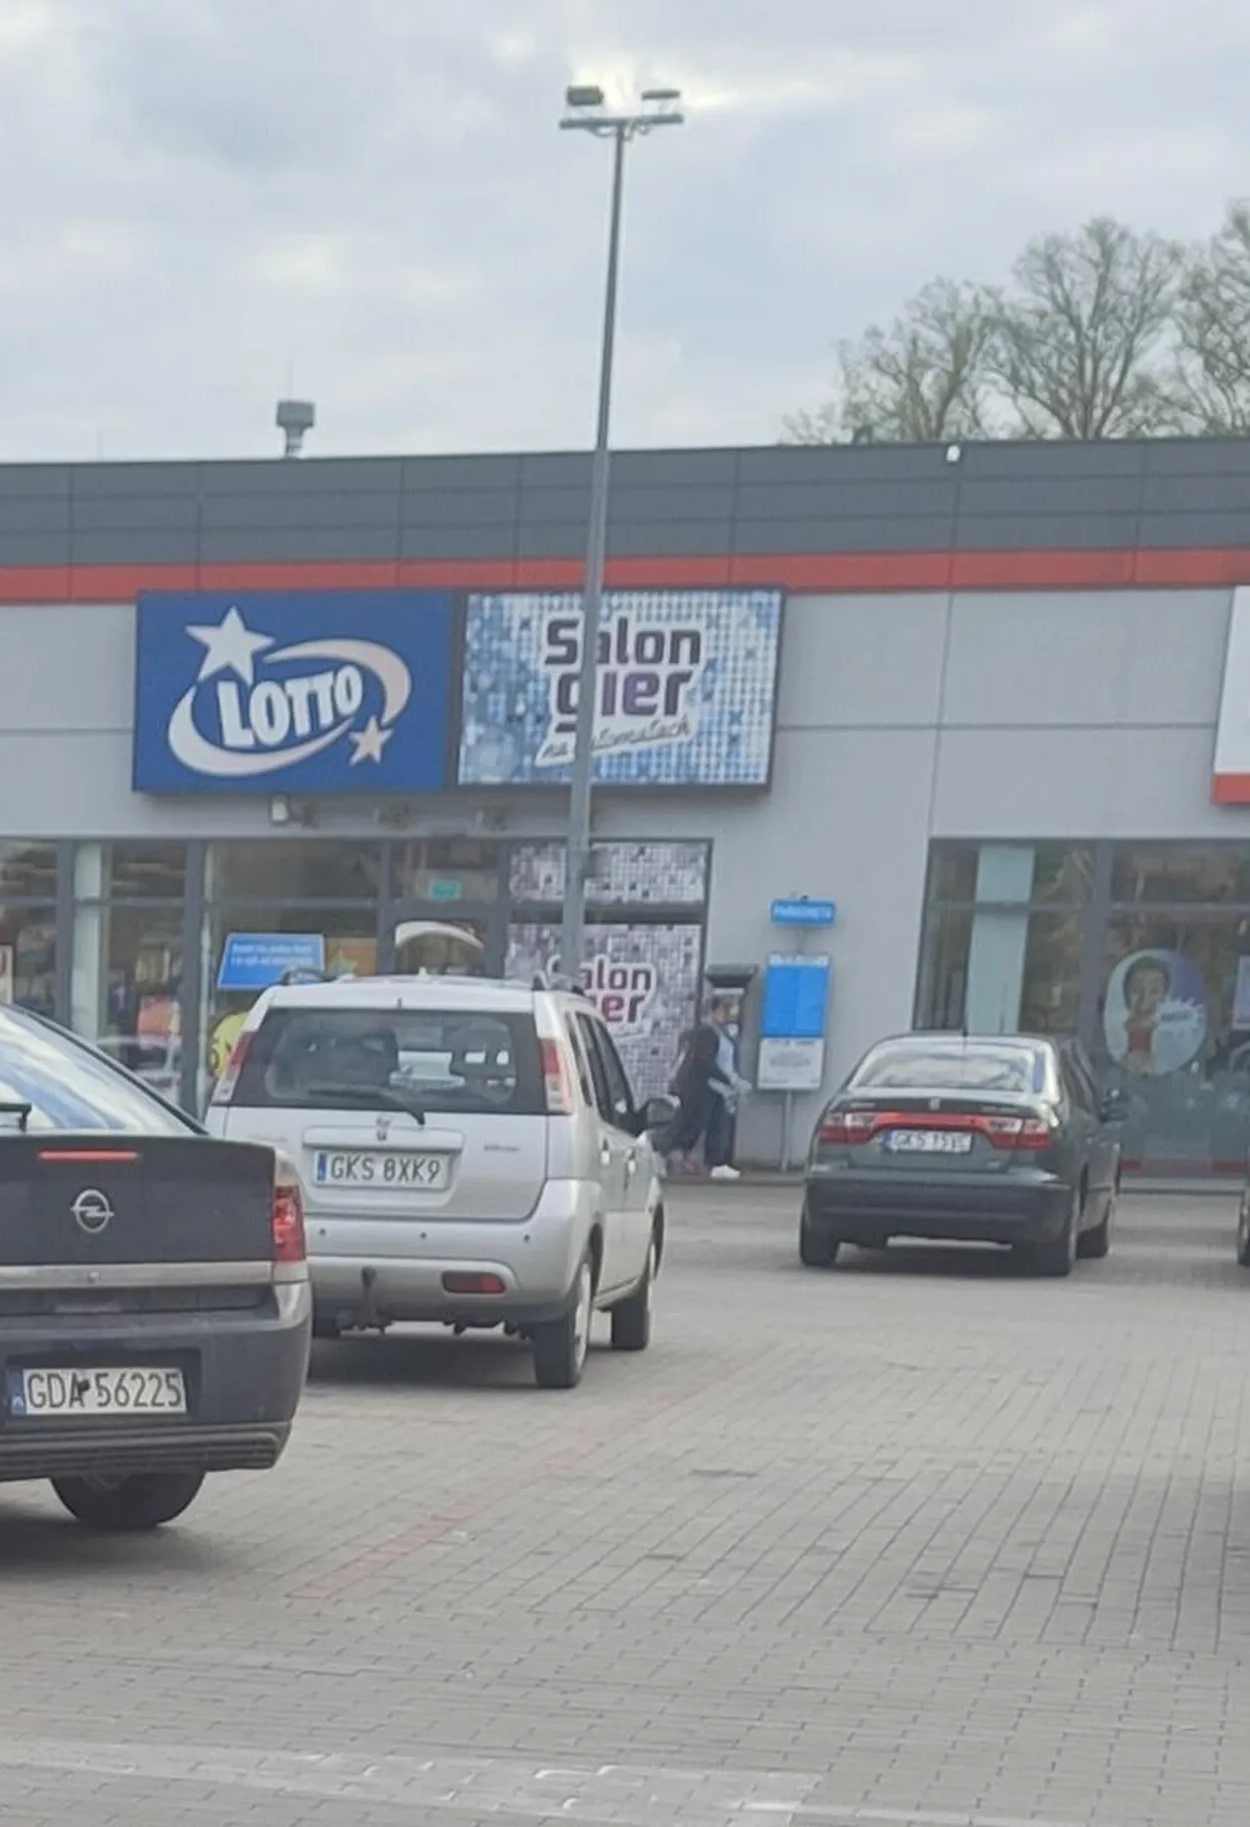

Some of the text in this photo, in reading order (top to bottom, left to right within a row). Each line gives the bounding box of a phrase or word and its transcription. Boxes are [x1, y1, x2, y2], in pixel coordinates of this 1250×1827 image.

[217, 665, 363, 748] LOTTO
[330, 1154, 442, 1184] GKS 8XK9
[26, 1370, 183, 1409] GDA 56225
